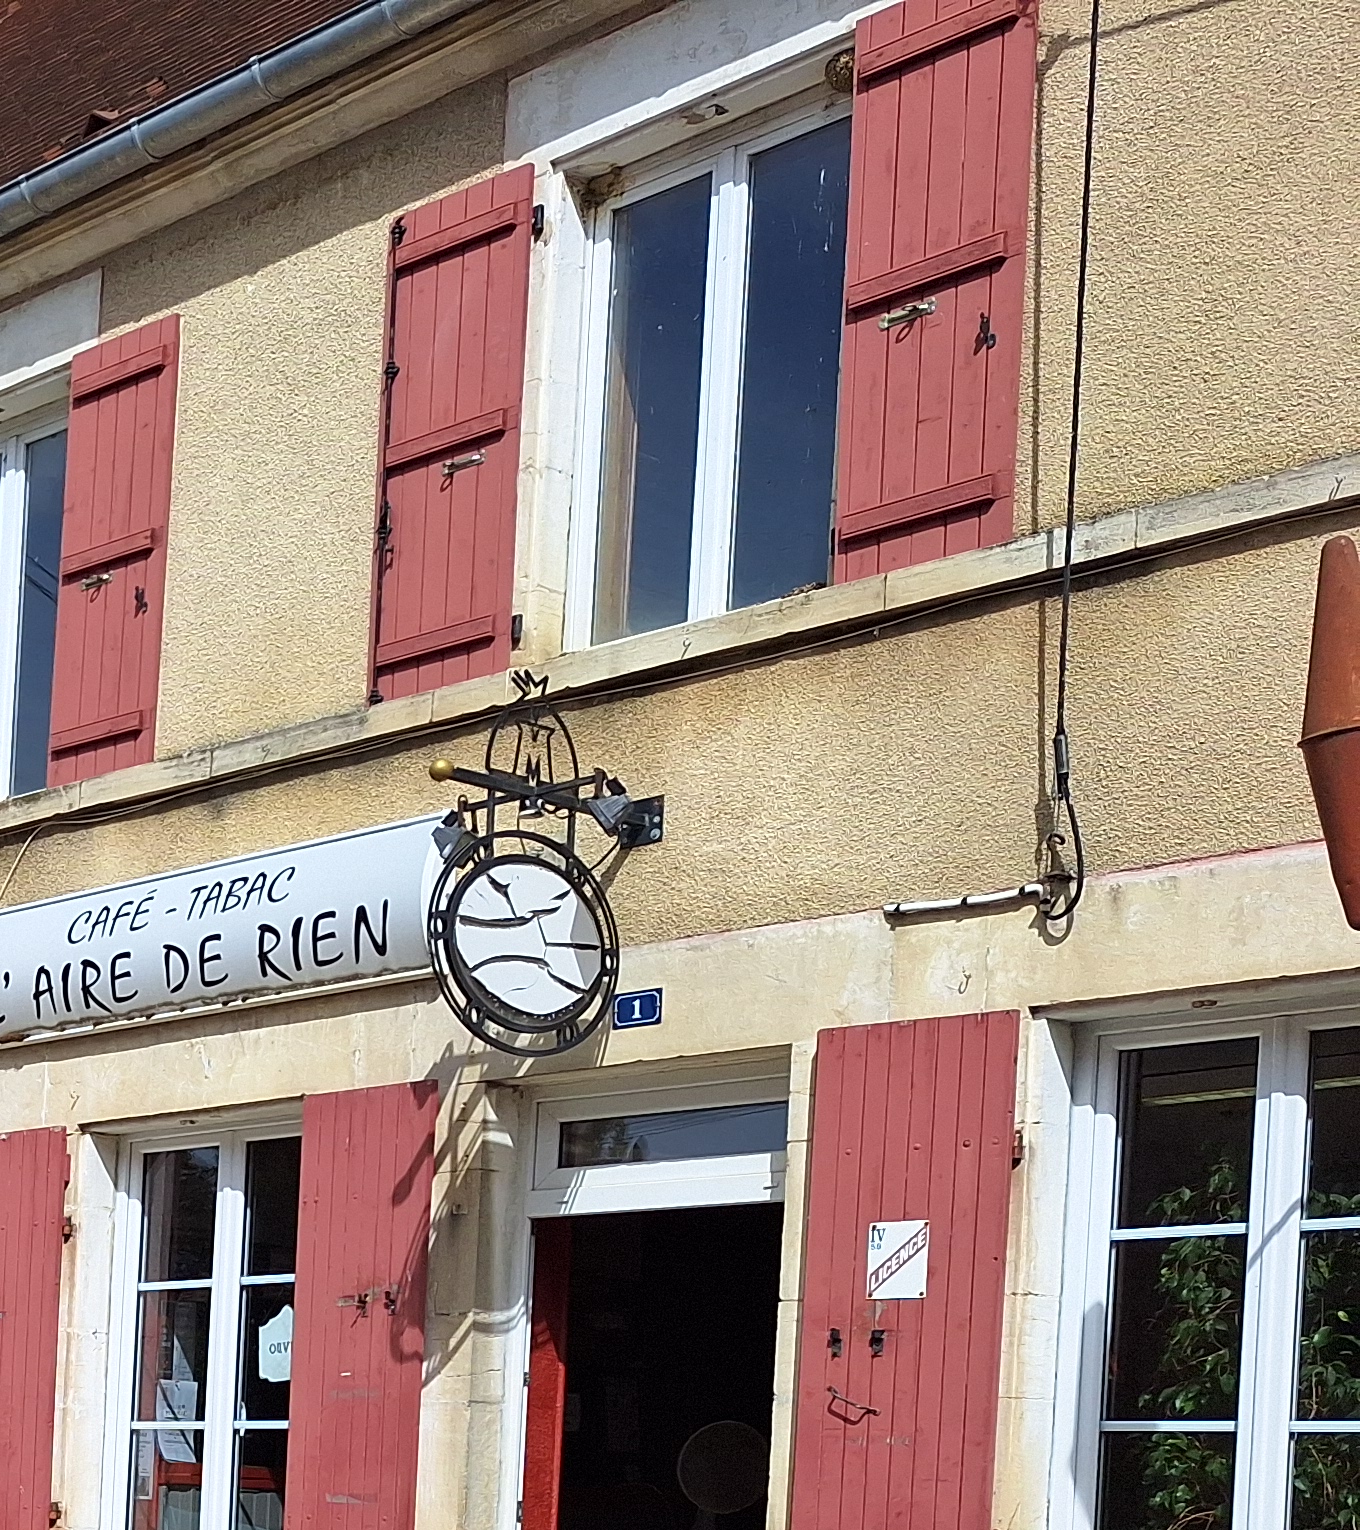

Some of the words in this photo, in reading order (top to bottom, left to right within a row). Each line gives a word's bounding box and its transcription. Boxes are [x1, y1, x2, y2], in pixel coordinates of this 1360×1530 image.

[67, 889, 158, 945] CAFÉ
[186, 866, 296, 921] TABAC
[162, 934, 229, 994] DE
[257, 900, 389, 982] RIEN
[631, 998, 642, 1019] 1
[871, 1228, 927, 1291] LICENCE
[268, 1341, 291, 1355] OUV
